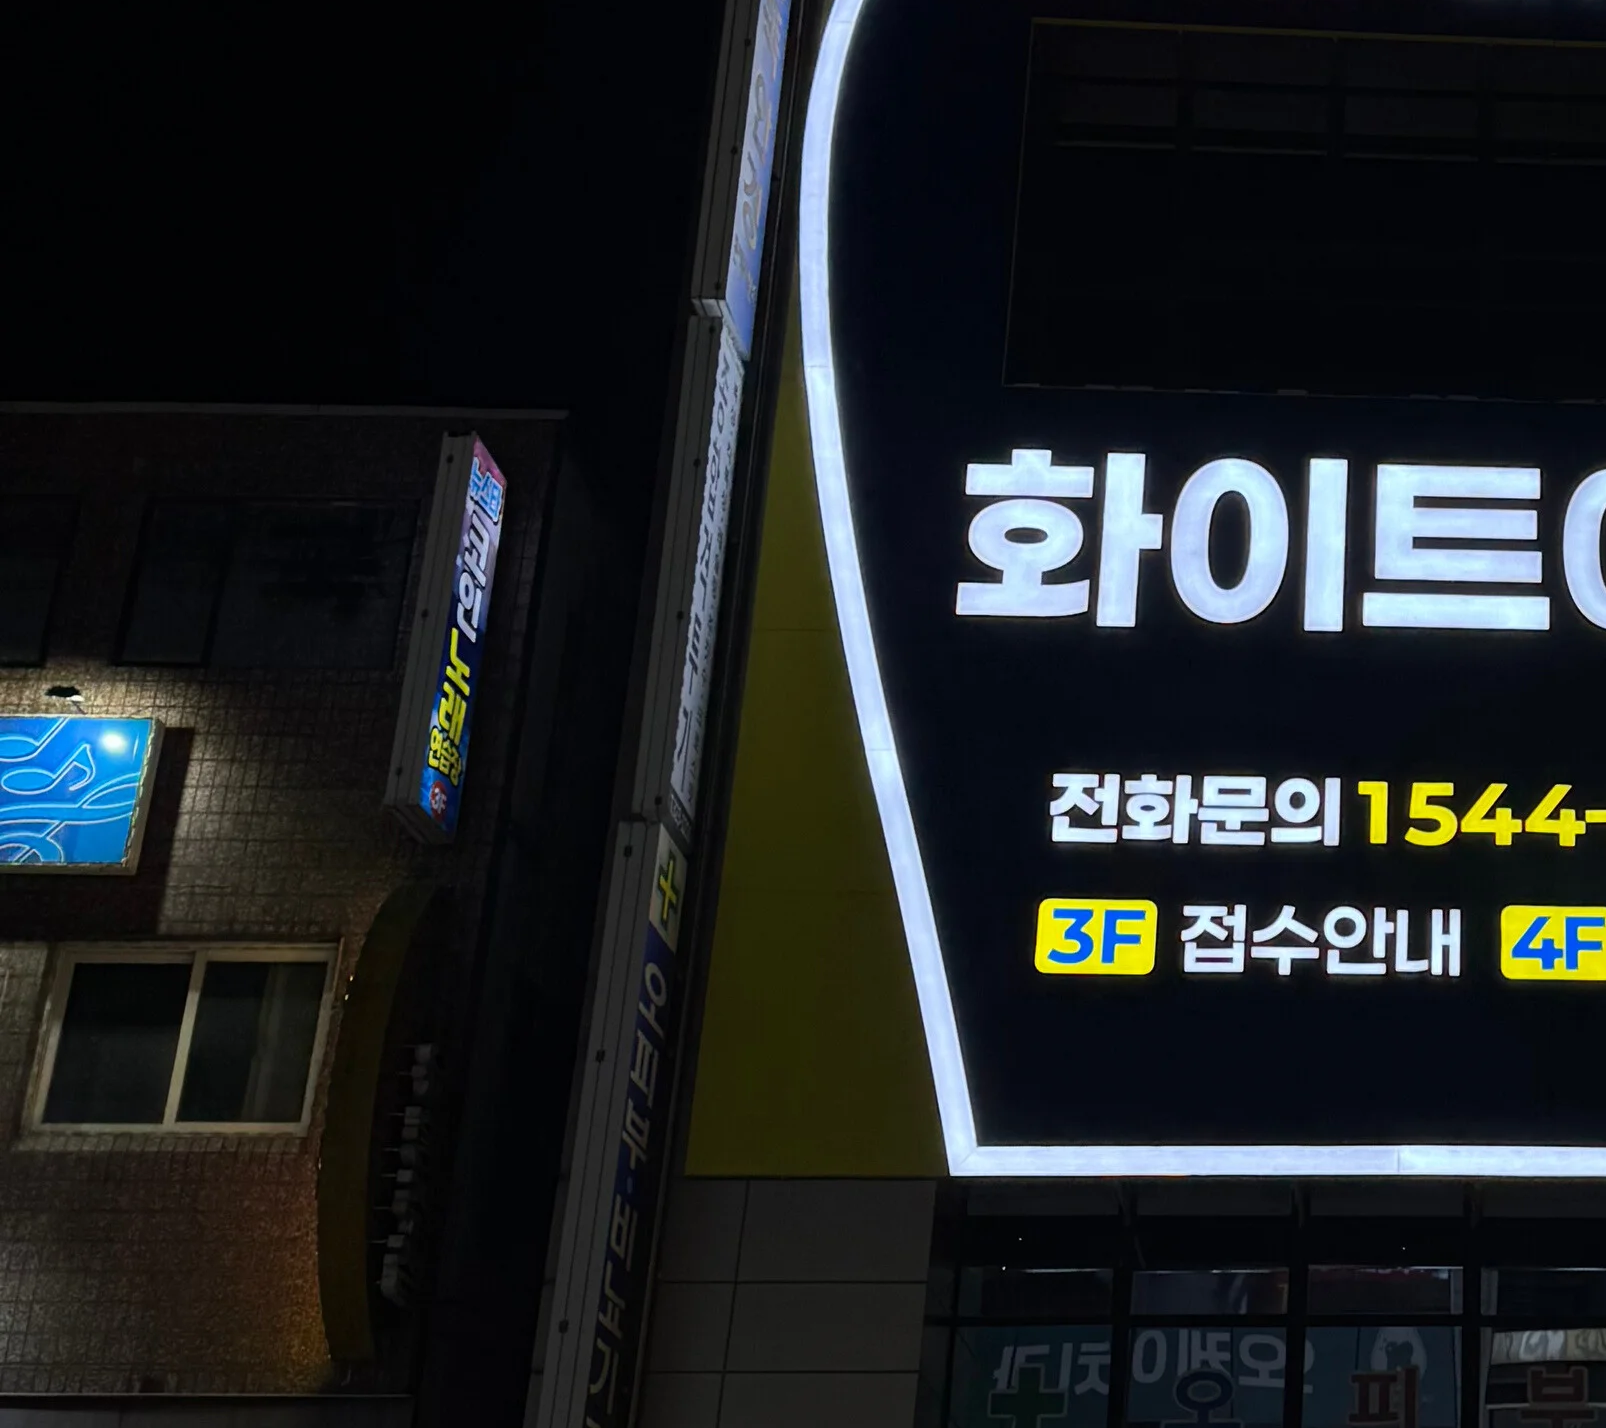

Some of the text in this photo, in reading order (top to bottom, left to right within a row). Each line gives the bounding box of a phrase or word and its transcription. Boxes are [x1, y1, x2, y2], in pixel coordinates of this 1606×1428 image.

[1046, 773, 1342, 849] 전화문의
[1046, 907, 1147, 967] 3F
[1180, 905, 1464, 980] 접수안내
[1509, 915, 1606, 974] 4F
